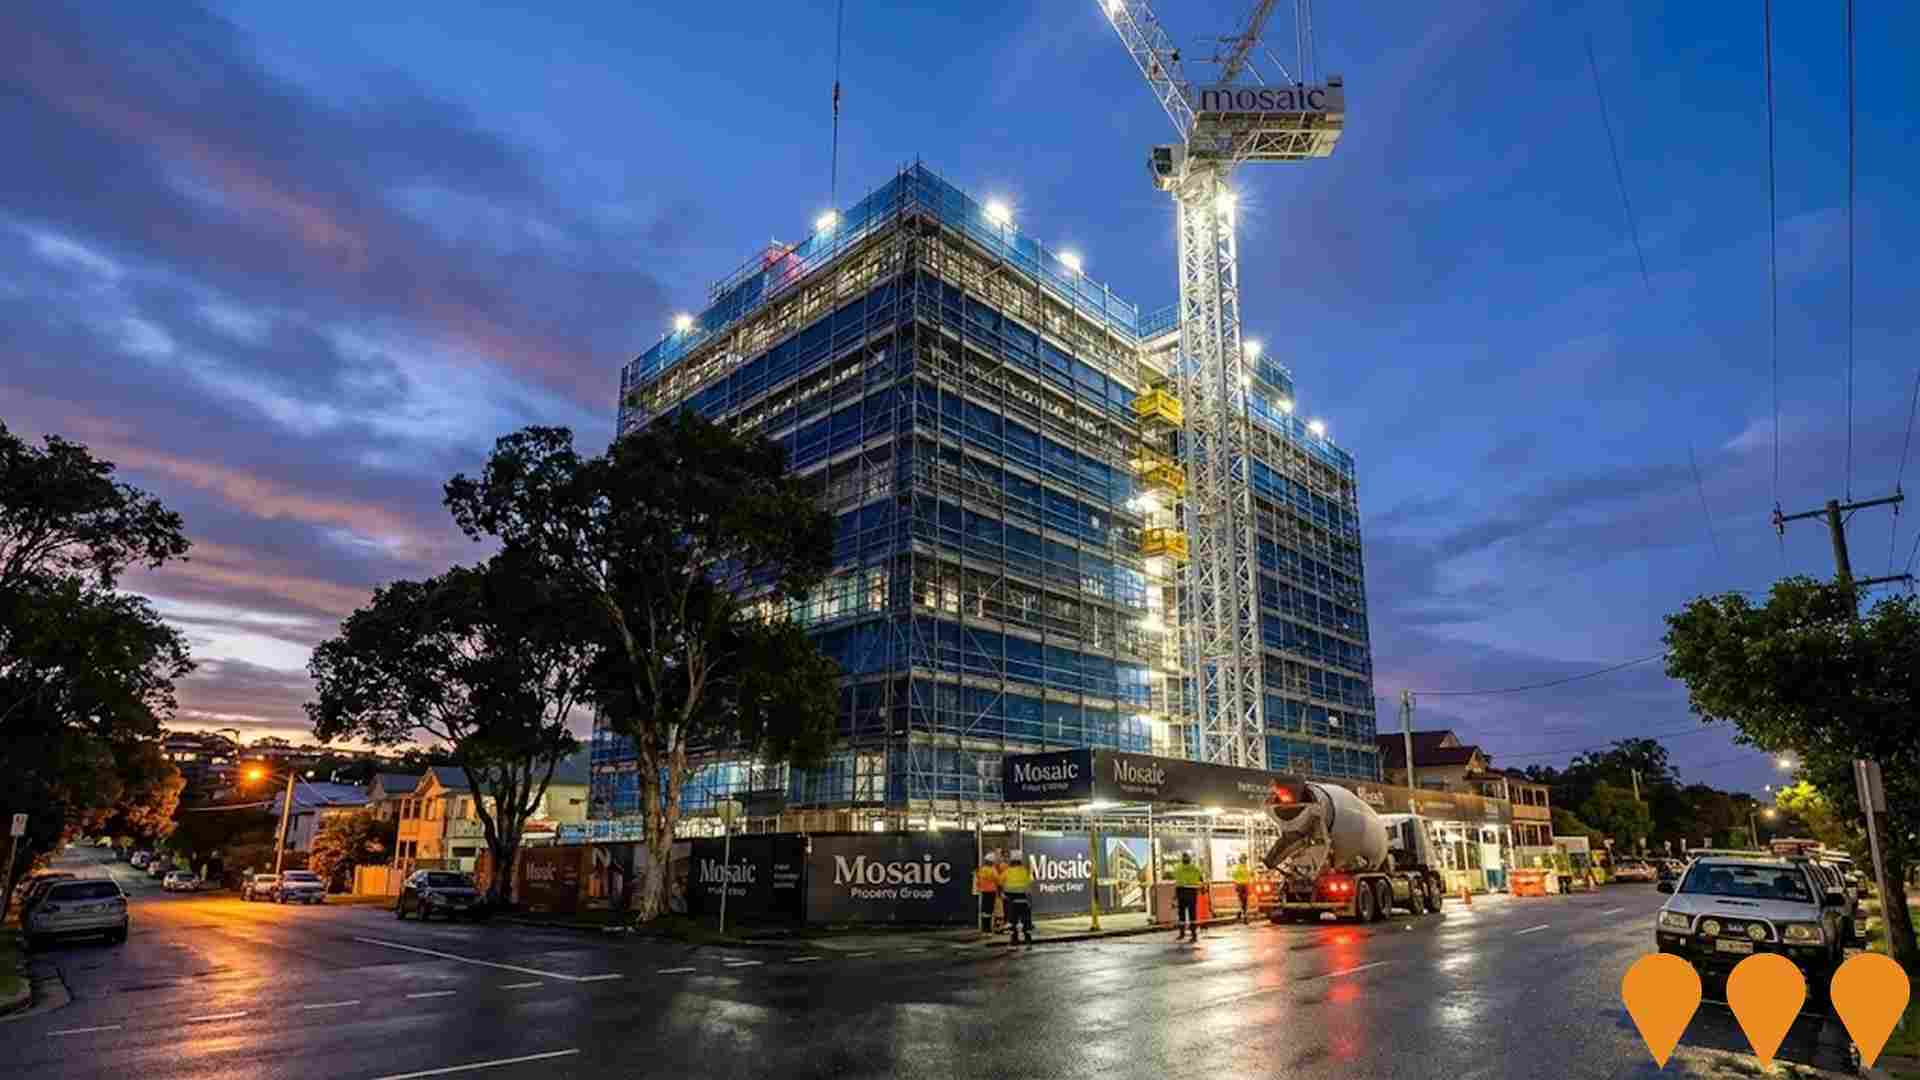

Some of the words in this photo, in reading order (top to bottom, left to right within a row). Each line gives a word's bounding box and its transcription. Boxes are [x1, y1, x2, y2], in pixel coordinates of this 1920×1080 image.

[1202, 82, 1326, 111] mosaic
[1014, 759, 1079, 784] Mosaic
[1113, 759, 1166, 785] Mosaic
[834, 854, 951, 884] Mosaic
[1029, 852, 1092, 881] Mosaic
